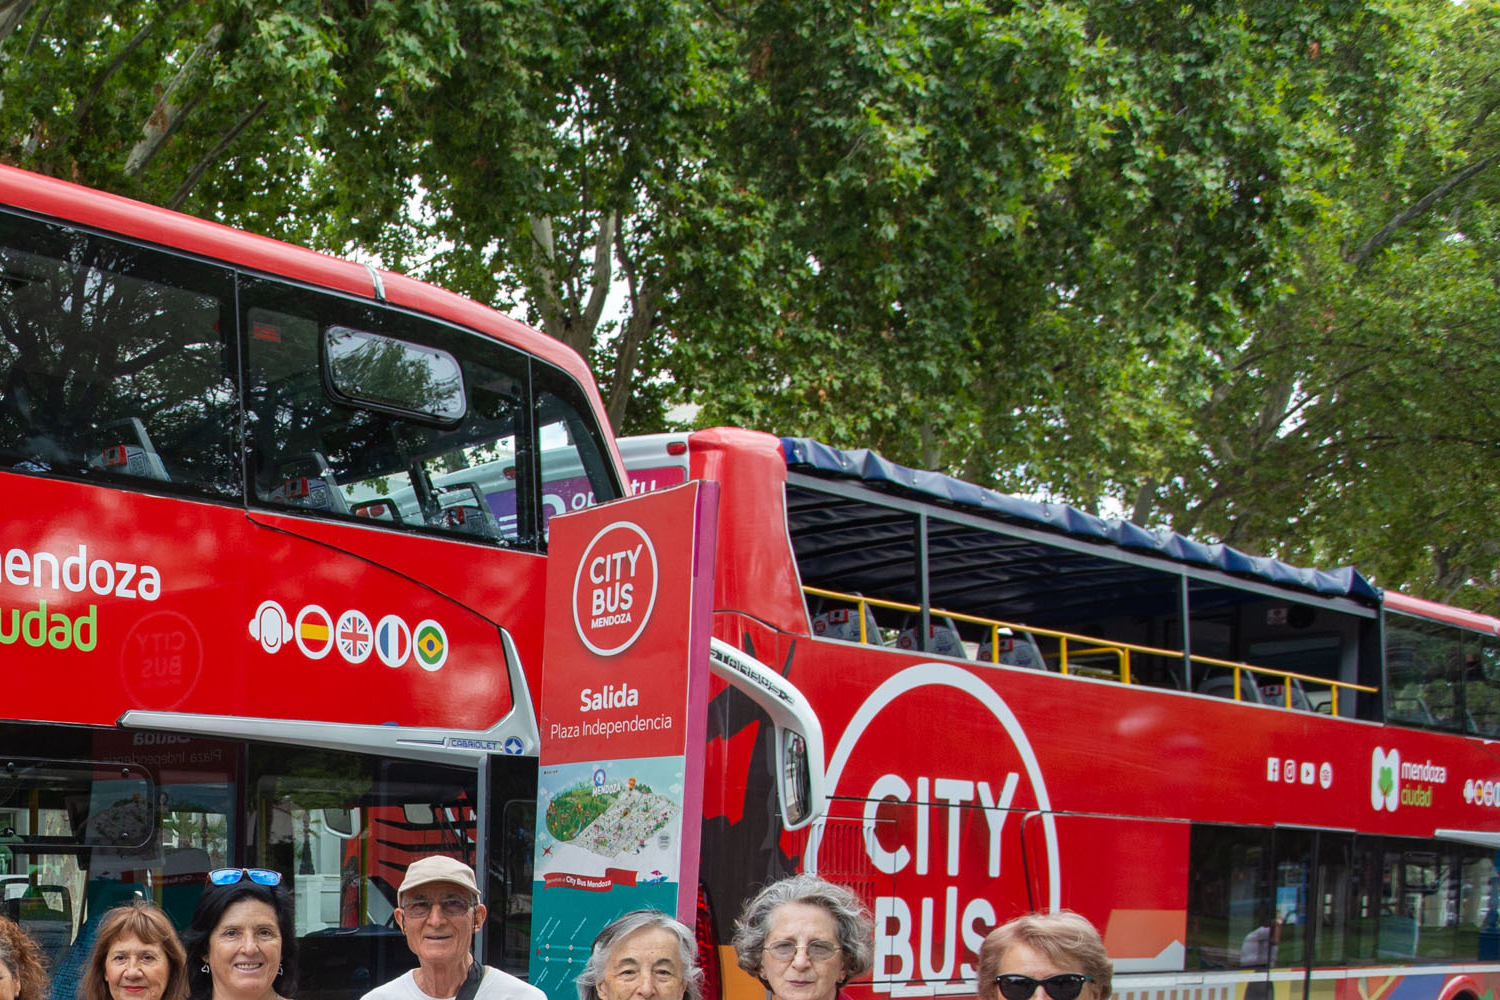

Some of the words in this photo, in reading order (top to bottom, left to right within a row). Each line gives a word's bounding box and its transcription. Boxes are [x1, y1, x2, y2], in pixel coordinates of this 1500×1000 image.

[589, 543, 643, 585] CITY
[591, 582, 634, 617] BUS
[591, 612, 632, 630] MENDOZA
[579, 682, 639, 713] Salida
[550, 722, 580, 740] Plaza
[582, 713, 672, 740] Independencia
[451, 739, 497, 751] CABRIOLET
[1401, 759, 1447, 784] mendoza
[591, 783, 621, 798] MENDOZA
[1401, 783, 1433, 808] ciudad
[862, 771, 1020, 879] CITY
[565, 875, 577, 887] City
[577, 878, 587, 887] Bus
[587, 879, 612, 888] Mendoza
[872, 886, 997, 998] BUS
